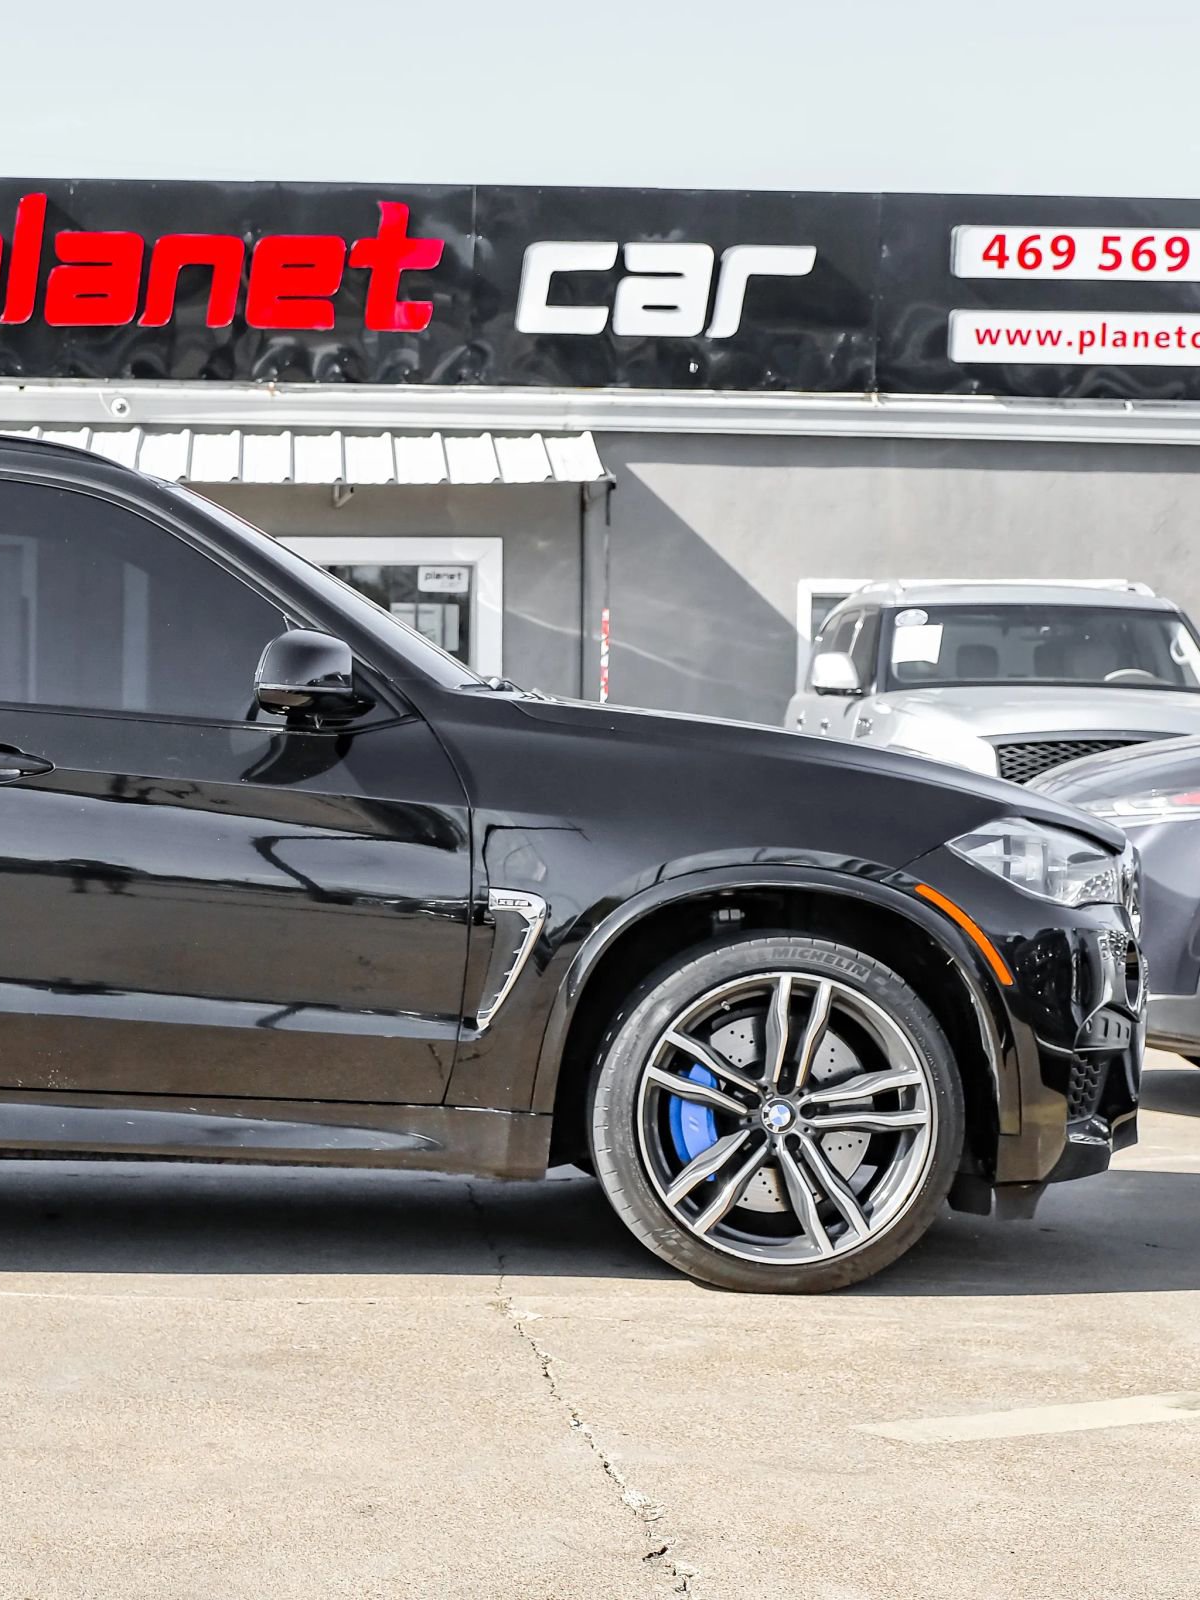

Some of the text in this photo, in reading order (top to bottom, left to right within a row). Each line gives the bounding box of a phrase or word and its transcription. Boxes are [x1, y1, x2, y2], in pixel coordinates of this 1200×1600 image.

[981, 233, 1191, 272] 469 569
[514, 240, 817, 339] car
[770, 946, 870, 978] MICHELIN
